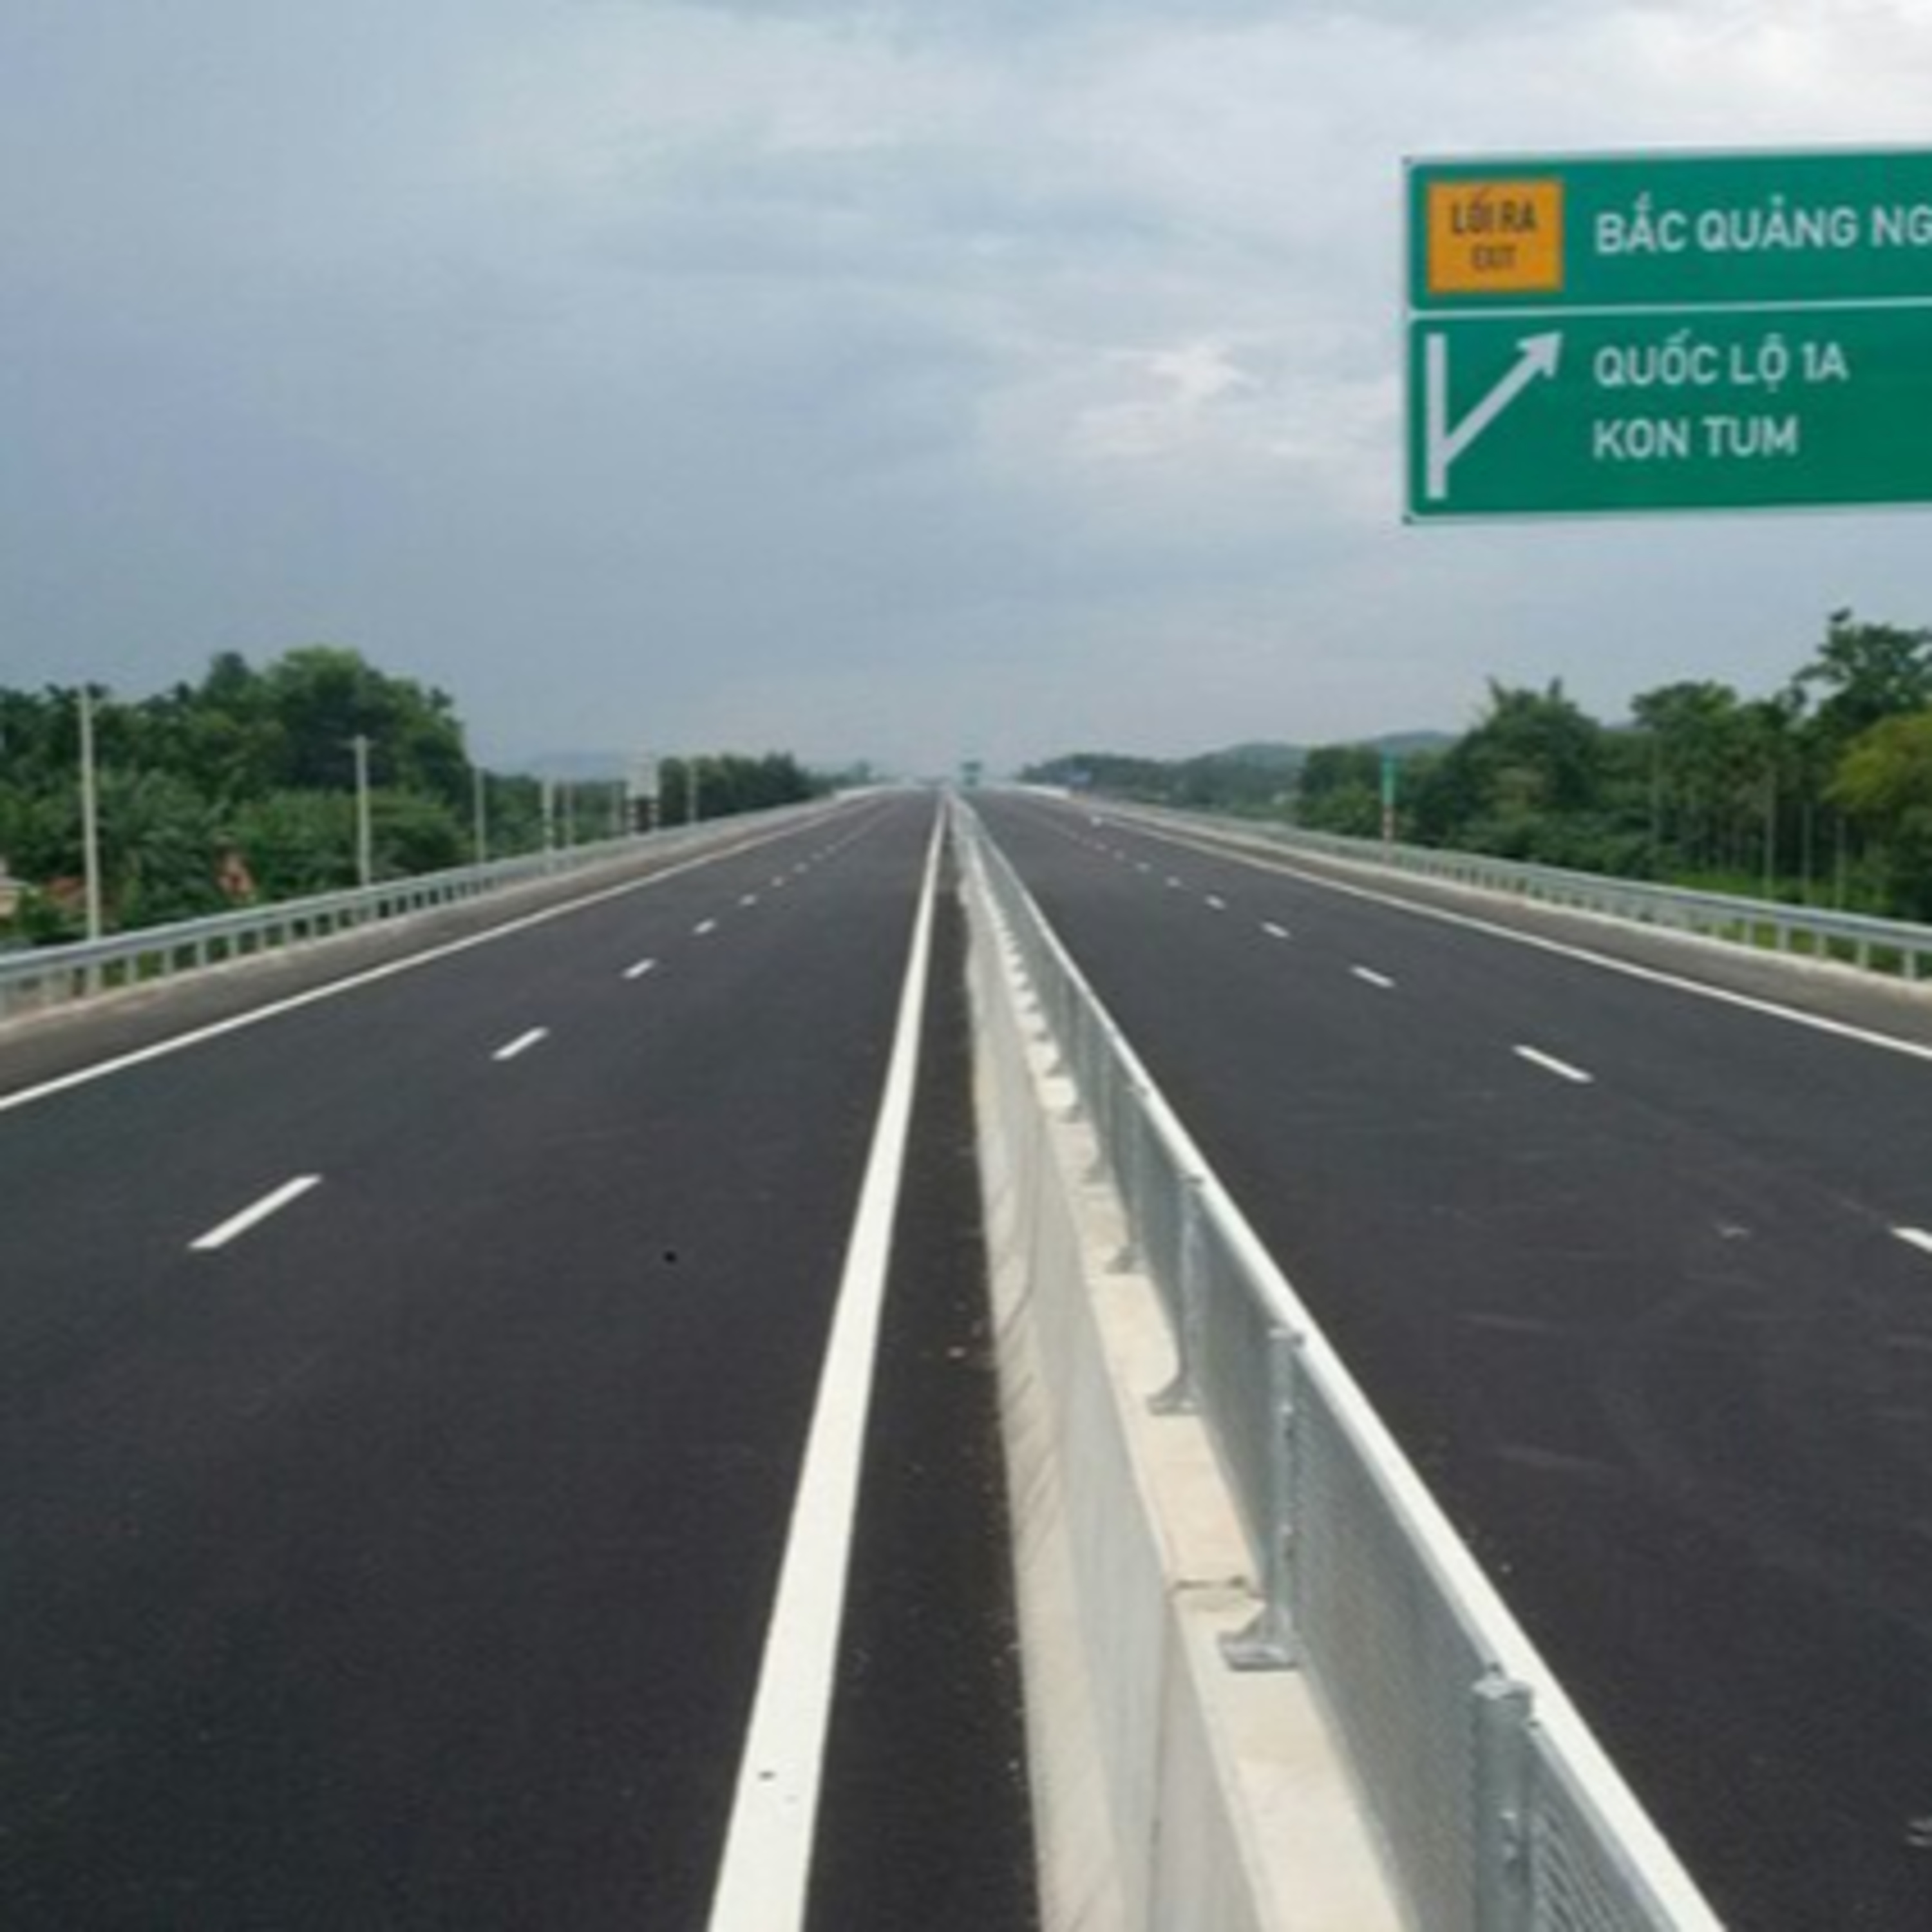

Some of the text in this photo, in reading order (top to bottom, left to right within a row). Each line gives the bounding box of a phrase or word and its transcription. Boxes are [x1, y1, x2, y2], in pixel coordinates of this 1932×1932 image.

[1501, 200, 1537, 233] RA
[1596, 191, 1688, 254] BẮC
[1696, 194, 1859, 251] QUẢNG
[1594, 327, 1850, 393] QUỐC LỘ 1A
[1593, 413, 1799, 460] KON TUM
